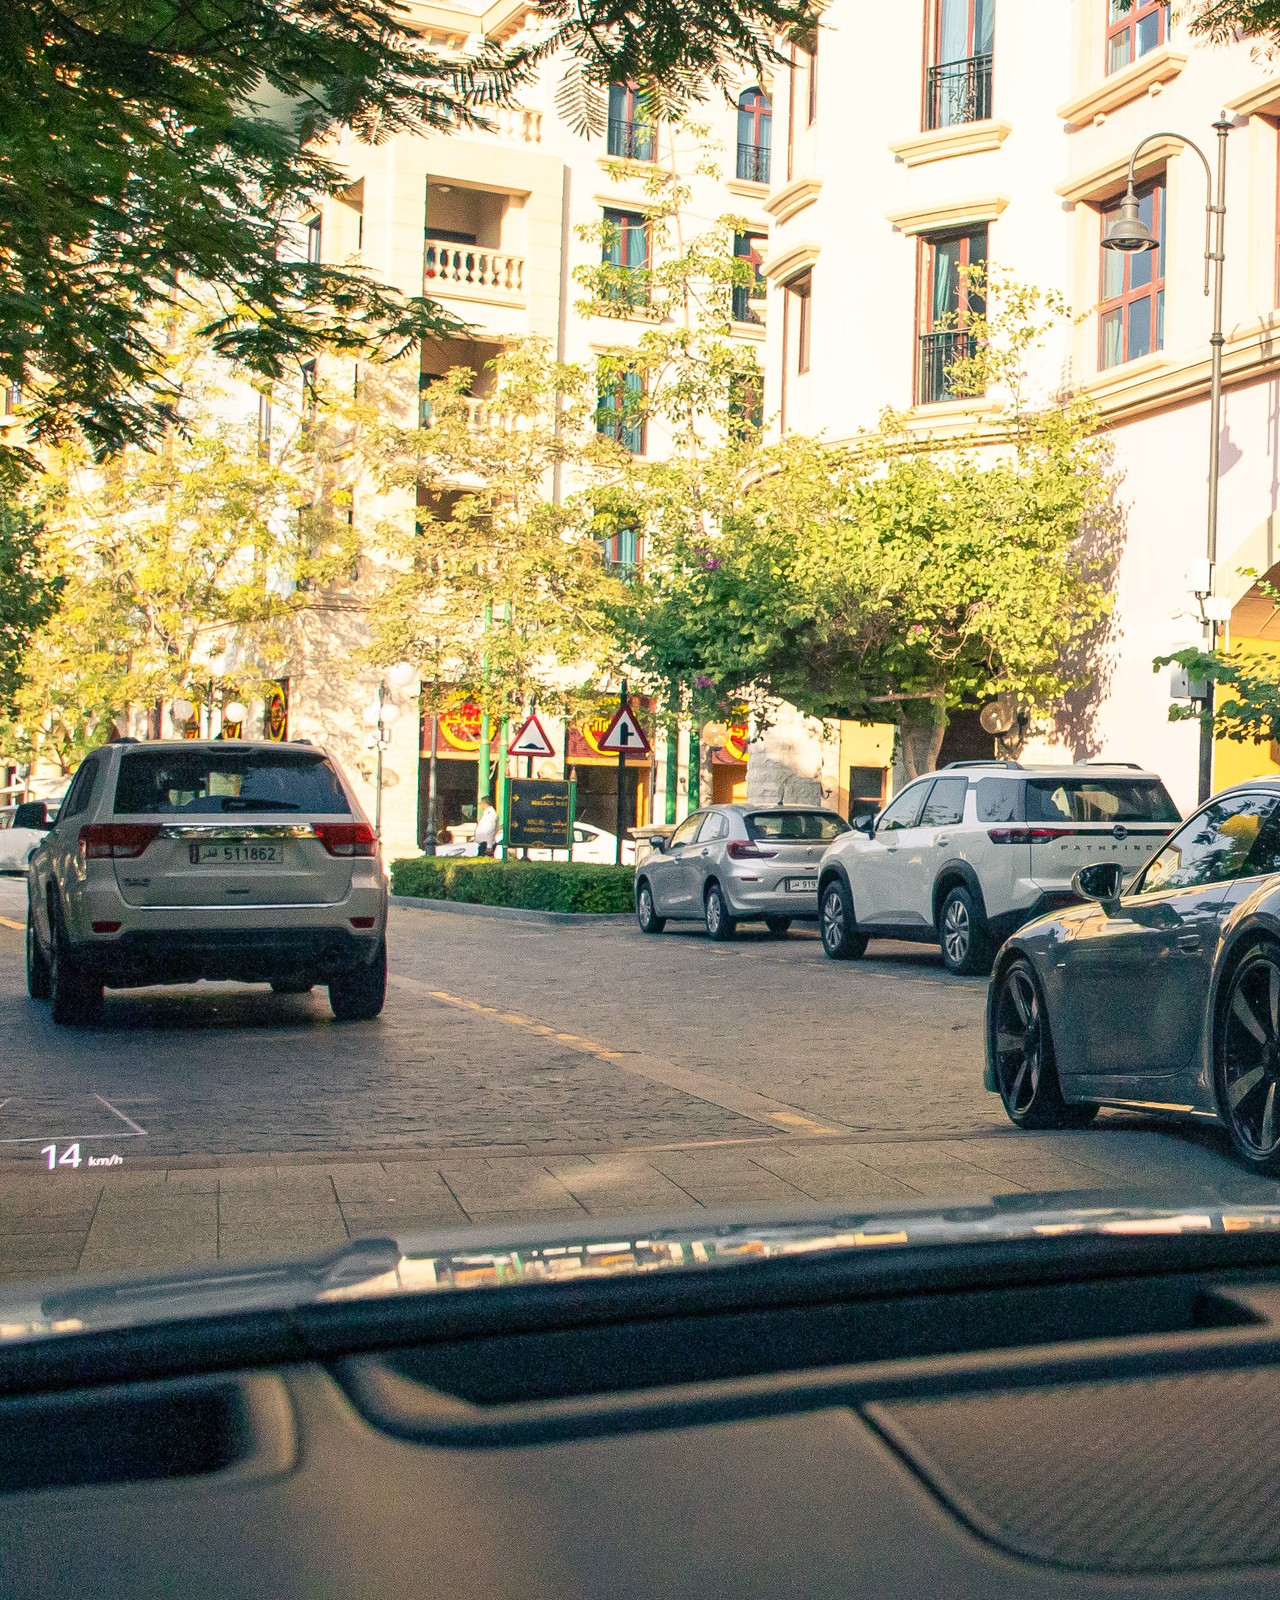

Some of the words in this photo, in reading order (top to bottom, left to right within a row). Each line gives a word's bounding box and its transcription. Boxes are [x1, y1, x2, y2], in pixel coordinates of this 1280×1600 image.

[1060, 844, 1161, 852] PATHFIND
[224, 847, 276, 861] 511862
[802, 880, 818, 889] 919
[41, 1143, 82, 1170] 14
[88, 1154, 124, 1167] km/h
